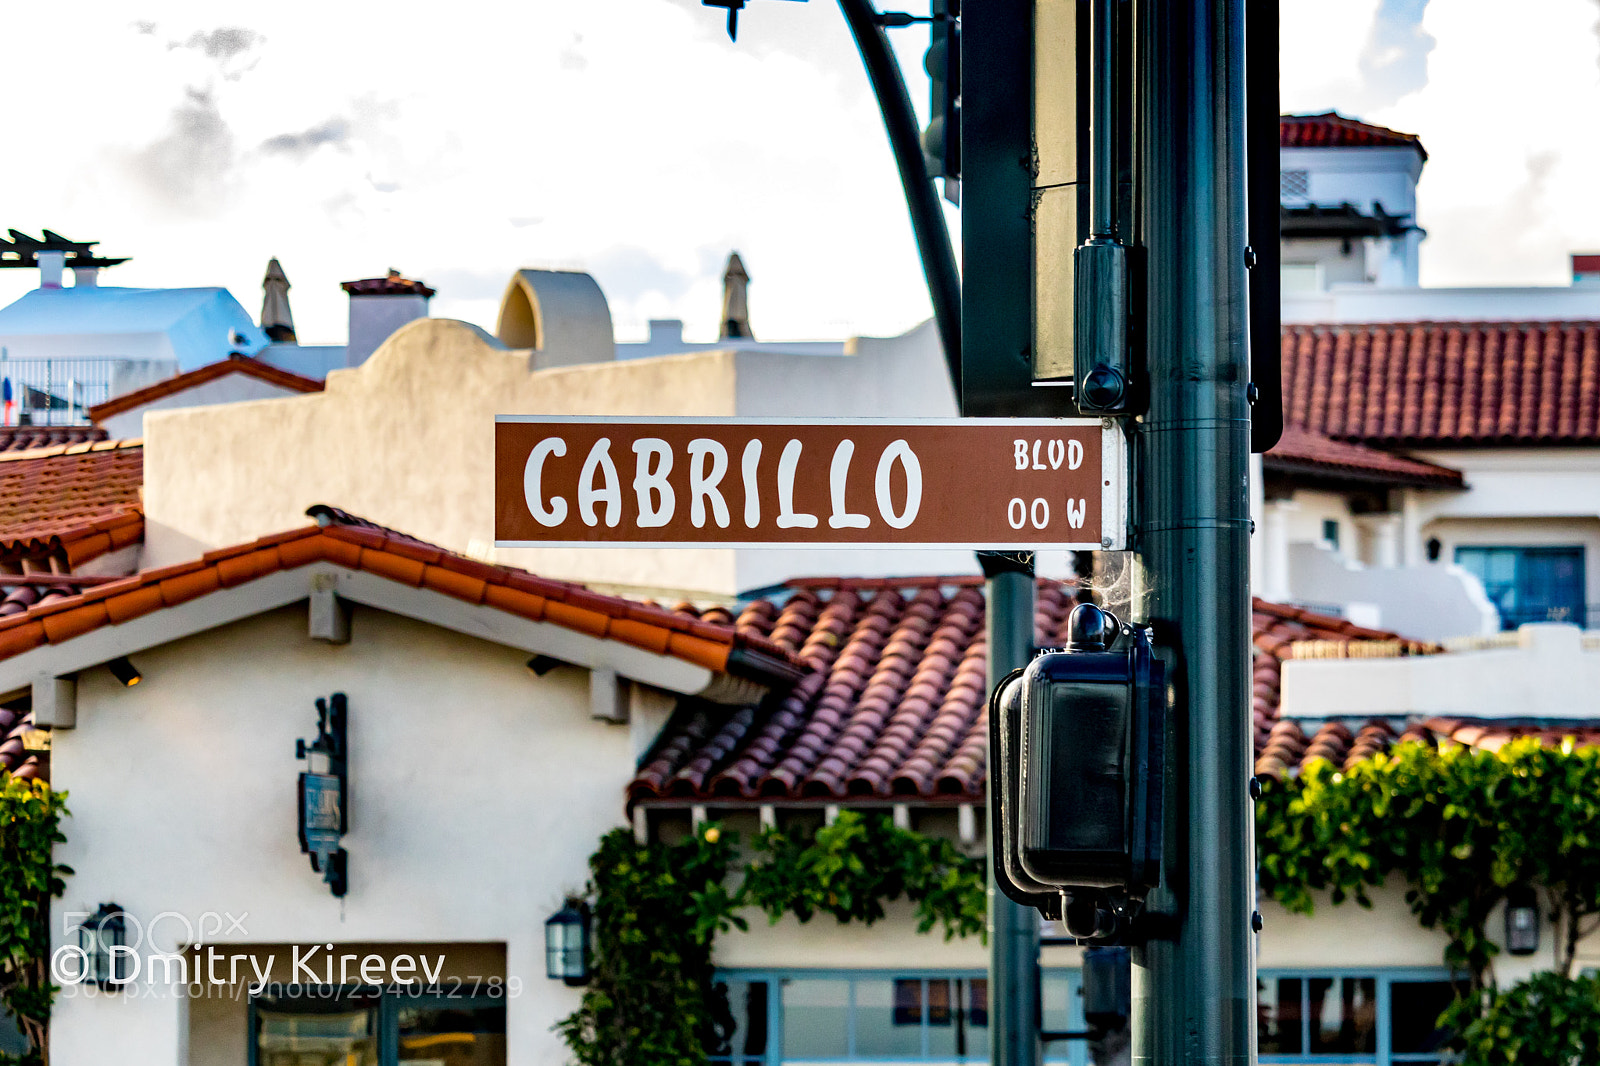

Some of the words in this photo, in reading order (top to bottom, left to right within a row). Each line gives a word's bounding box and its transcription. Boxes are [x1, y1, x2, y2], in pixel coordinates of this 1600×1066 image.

[1013, 438, 1084, 471] BLVD
[523, 436, 923, 529] CABRILLO
[1067, 497, 1086, 529] W
